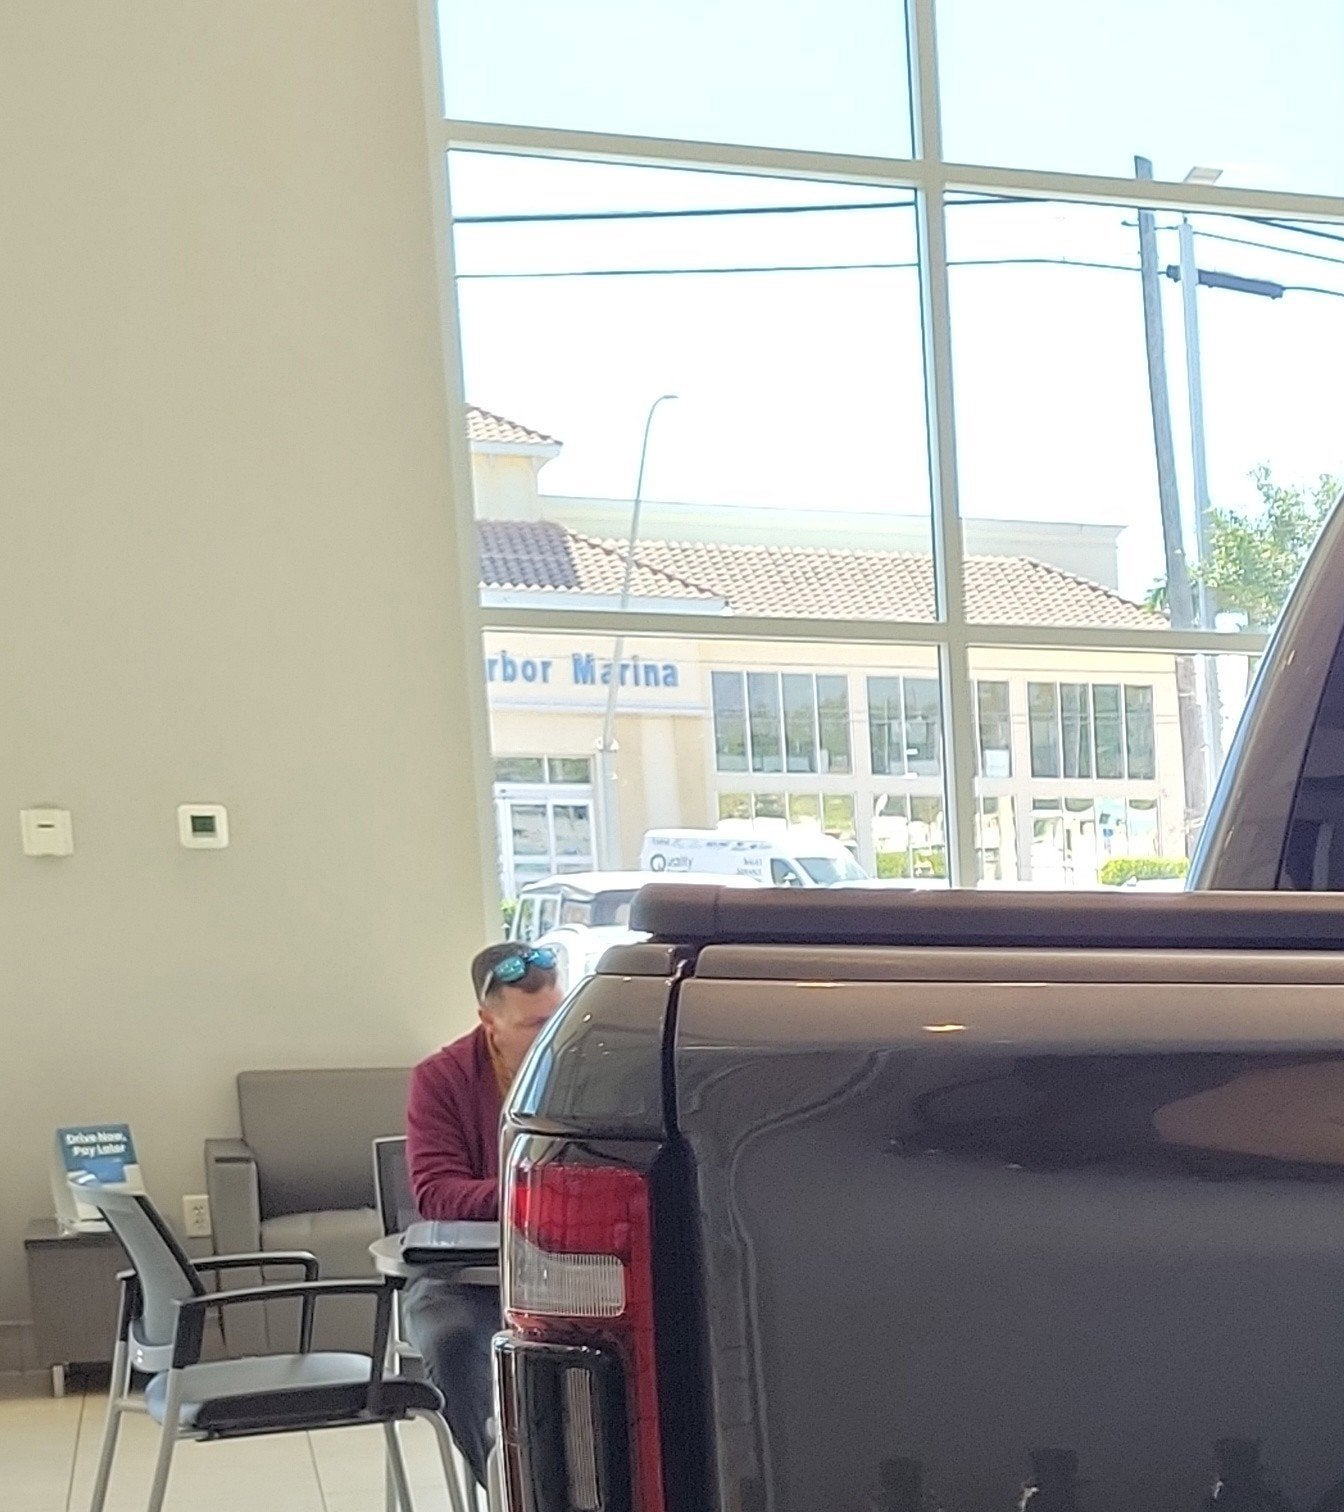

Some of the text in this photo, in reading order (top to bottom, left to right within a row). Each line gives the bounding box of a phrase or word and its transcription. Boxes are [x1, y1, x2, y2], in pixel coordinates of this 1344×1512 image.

[487, 650, 679, 688] rbor Marina
[65, 1132, 97, 1145] Drive
[72, 1143, 126, 1158] Pay Later
